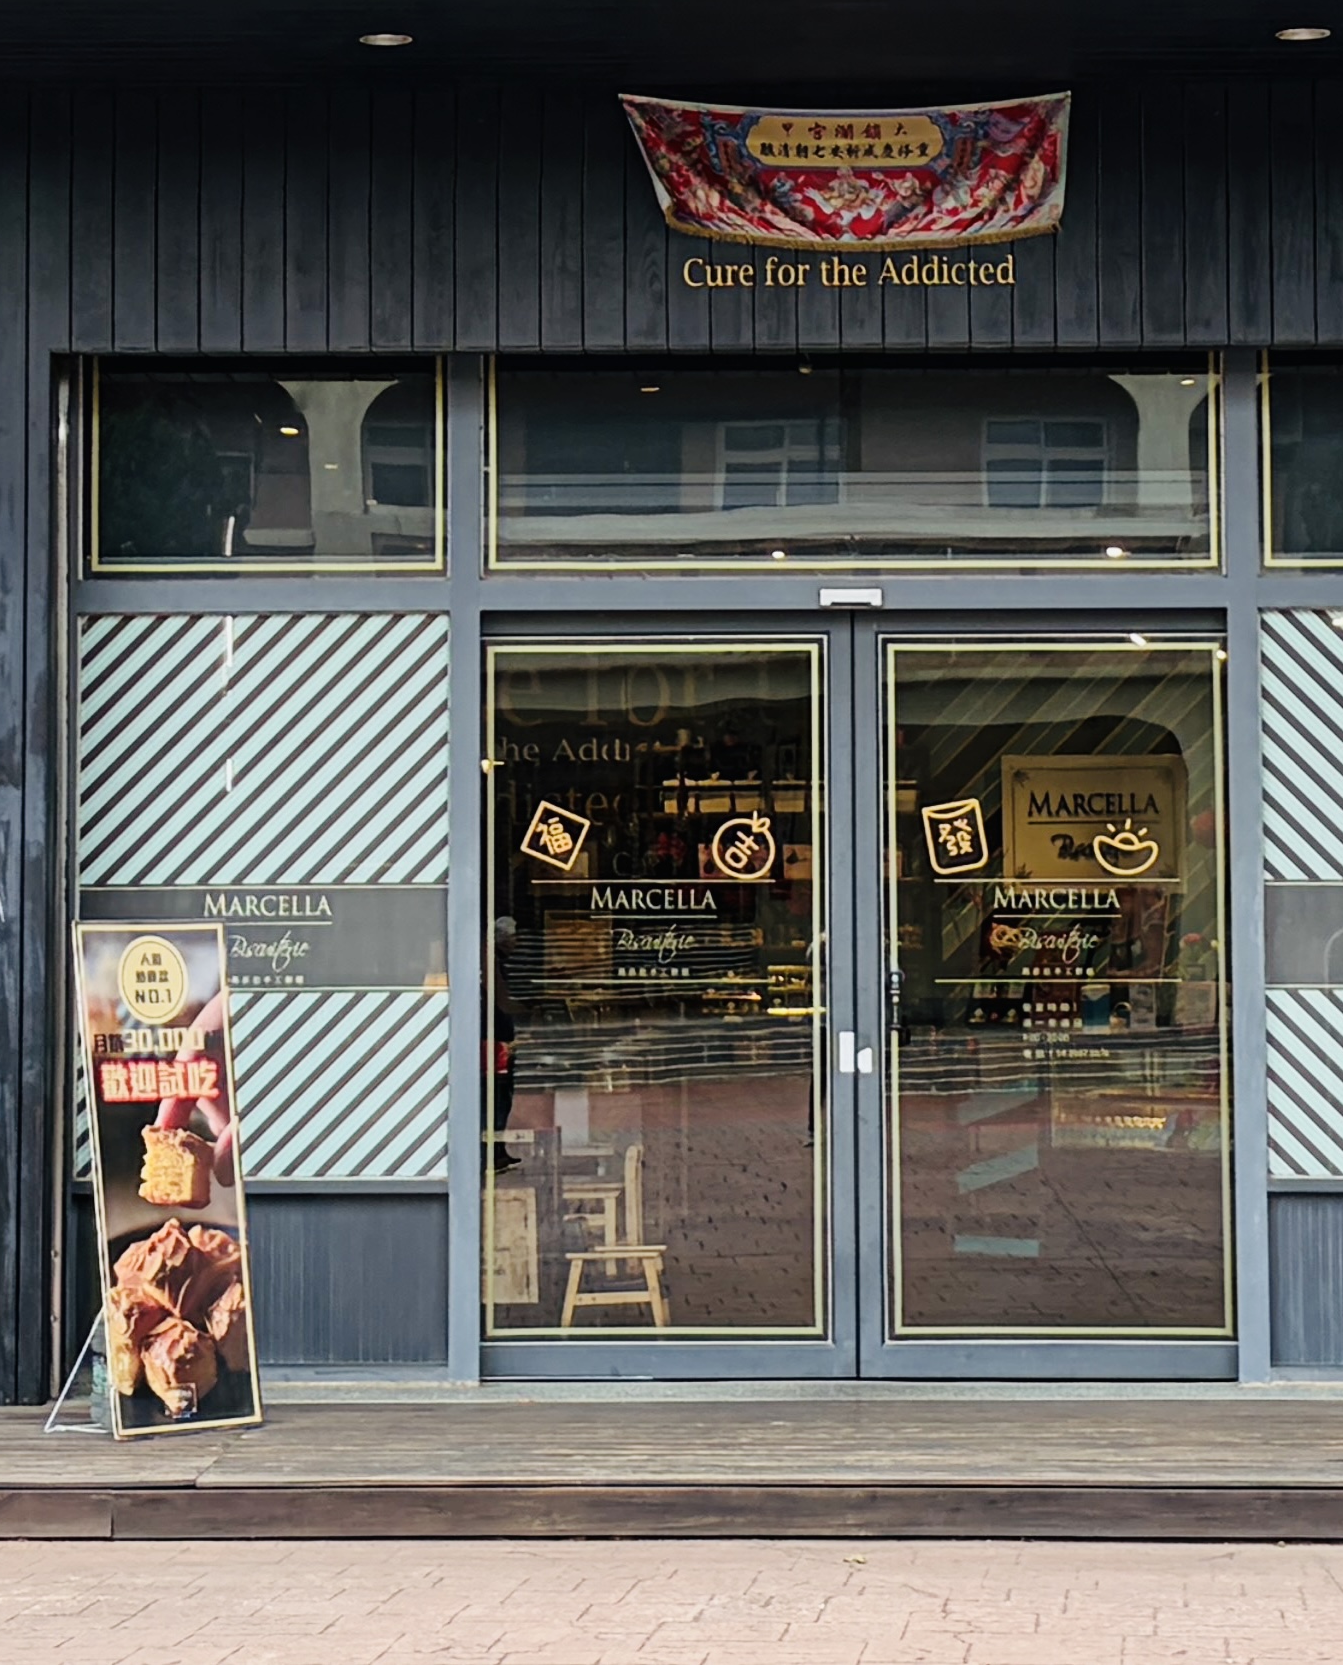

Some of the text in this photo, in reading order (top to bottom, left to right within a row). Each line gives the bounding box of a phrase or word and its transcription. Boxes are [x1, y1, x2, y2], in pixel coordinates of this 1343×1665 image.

[683, 254, 1015, 286] Cure for the Addicted
[1027, 791, 1160, 817] MARCELLA
[535, 817, 573, 855] 福
[204, 894, 332, 917] MARCELLA
[590, 886, 717, 910] MARCELLA
[993, 885, 1121, 910] MARCELLA
[100, 1059, 220, 1102] 歡迎試吃
